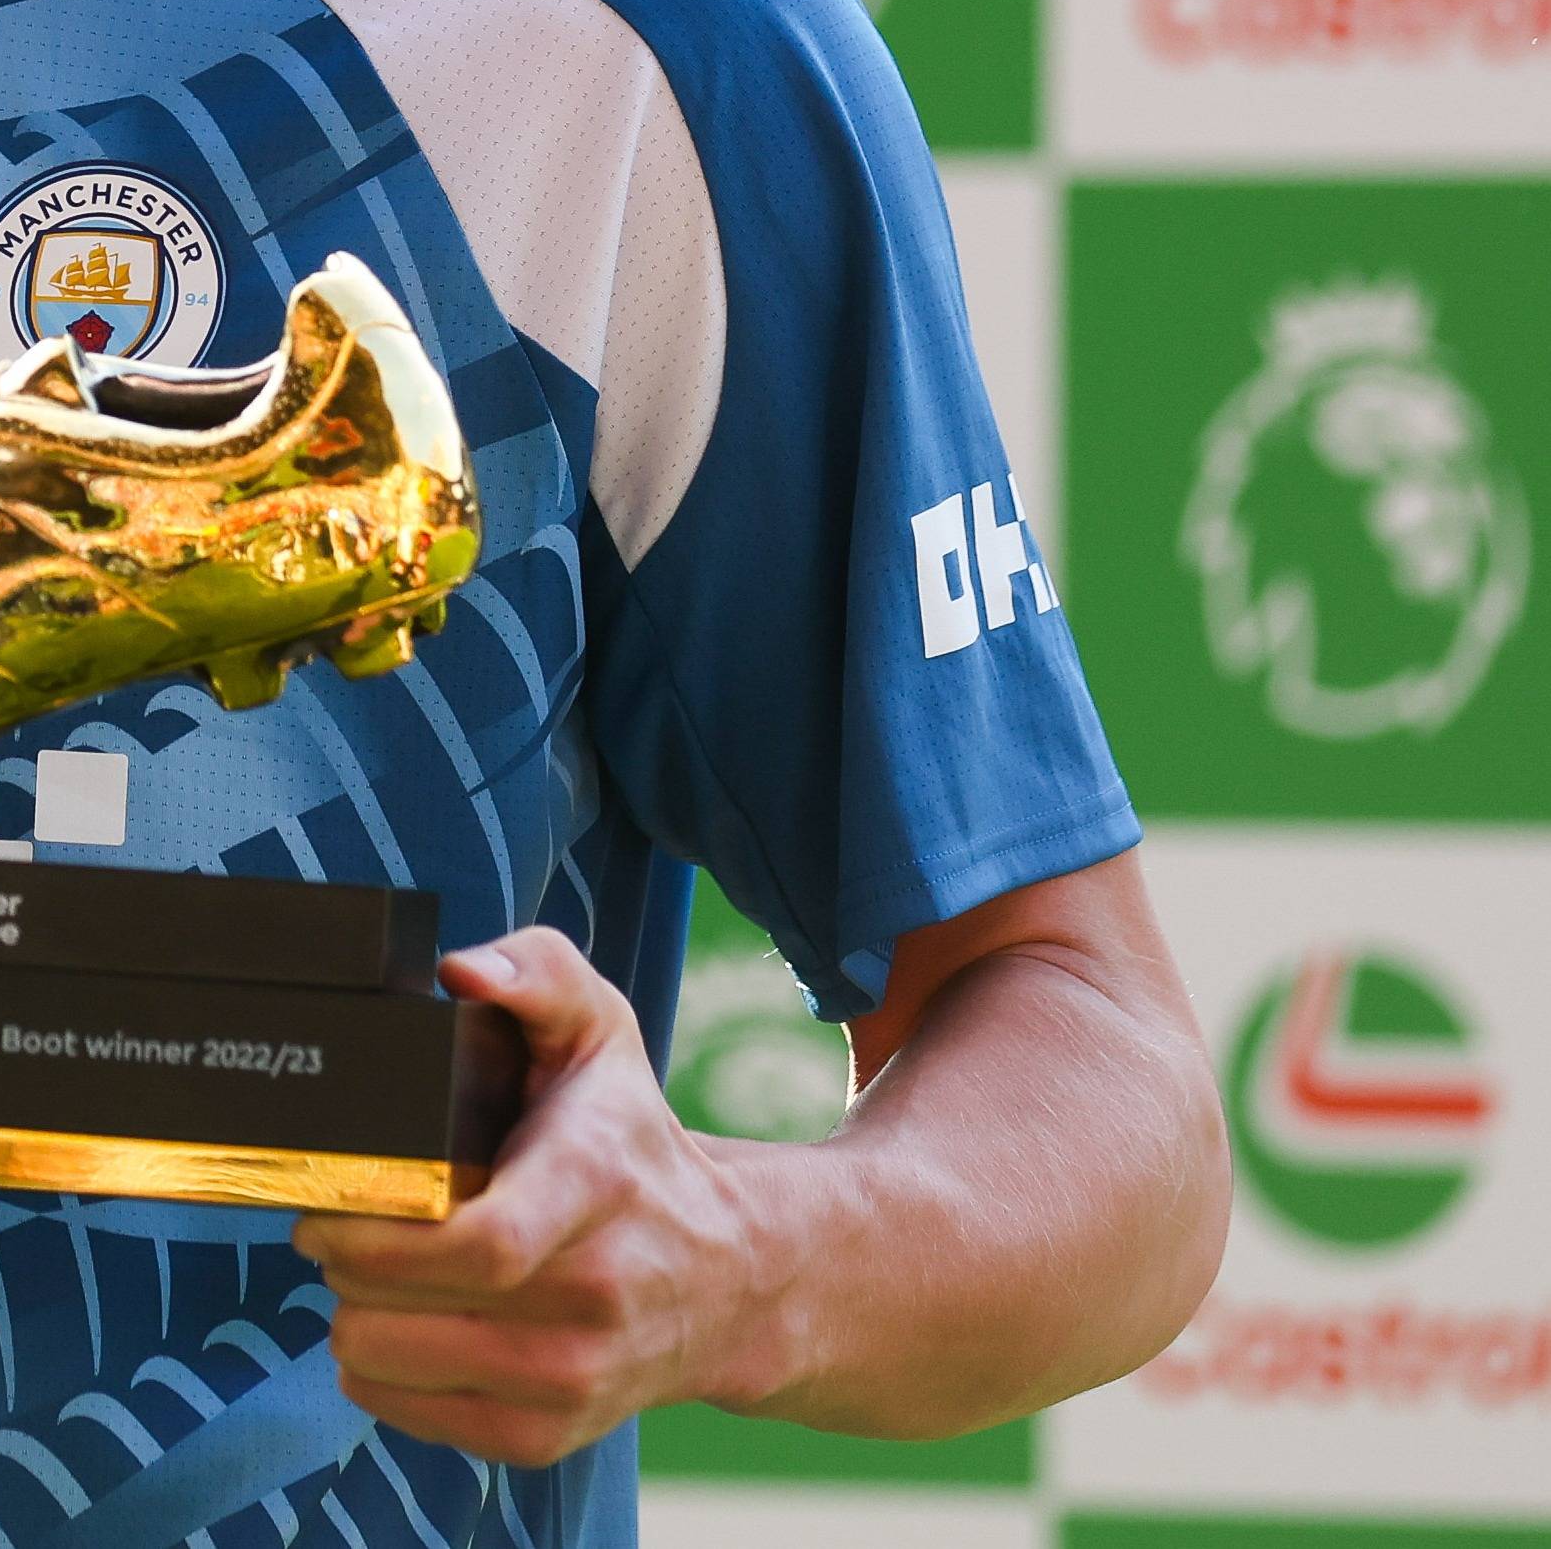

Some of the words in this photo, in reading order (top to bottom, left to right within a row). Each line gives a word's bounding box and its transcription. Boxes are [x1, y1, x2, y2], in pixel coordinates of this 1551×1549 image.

[184, 292, 209, 307] 94
[910, 472, 1061, 659] OK
[1, 1024, 79, 1058] Boot
[85, 1030, 196, 1065] winner
[202, 1038, 324, 1079] 2022/23
